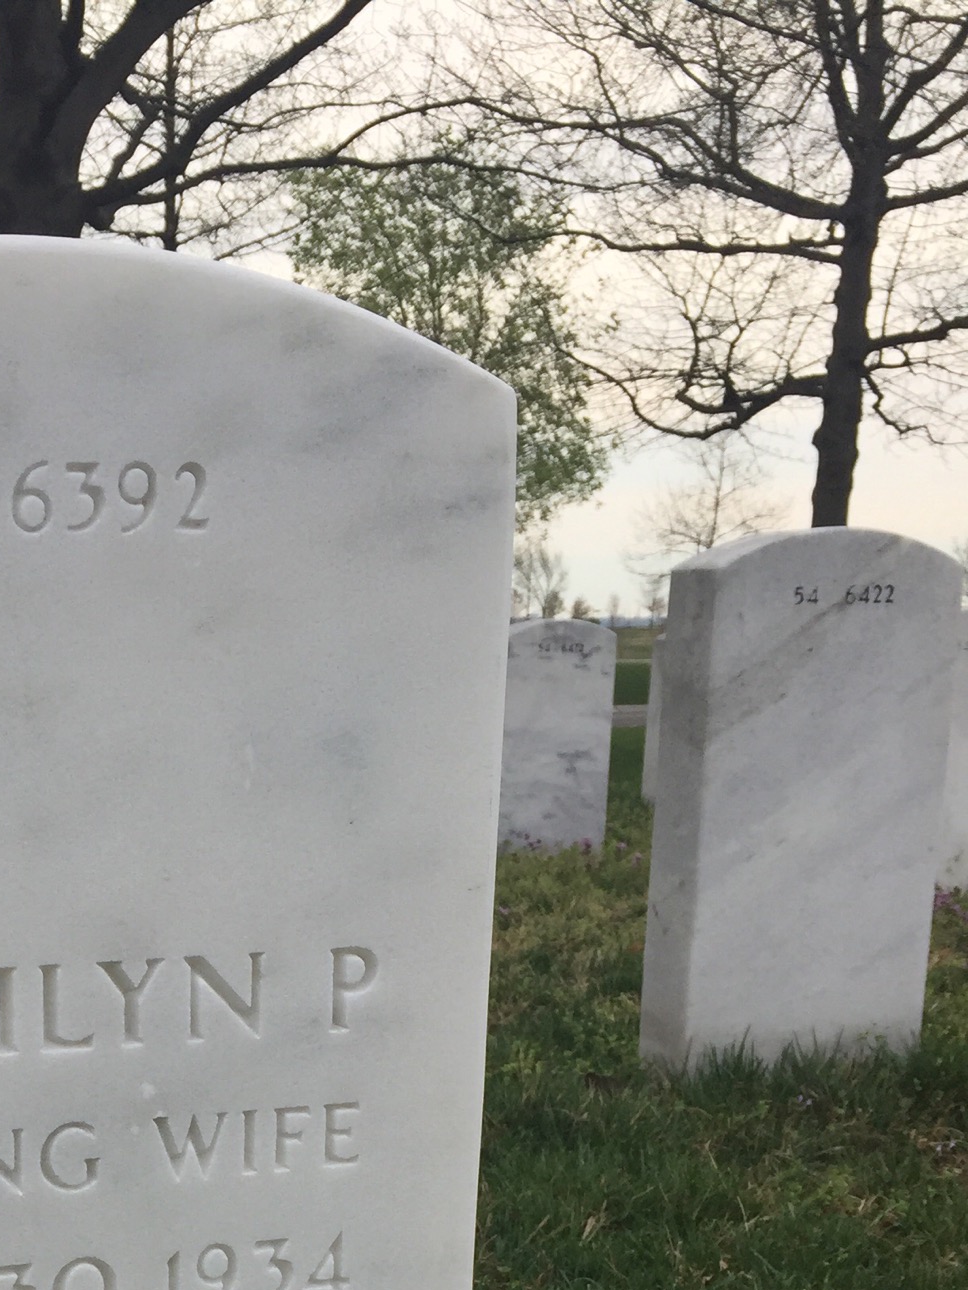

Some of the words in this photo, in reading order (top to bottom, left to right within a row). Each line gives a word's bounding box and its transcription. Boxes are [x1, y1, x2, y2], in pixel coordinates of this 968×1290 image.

[11, 459, 210, 534] 6392
[794, 586, 819, 605] 54
[844, 584, 895, 604] 6422
[329, 945, 379, 1034] P
[152, 1101, 361, 1182] WIFE
